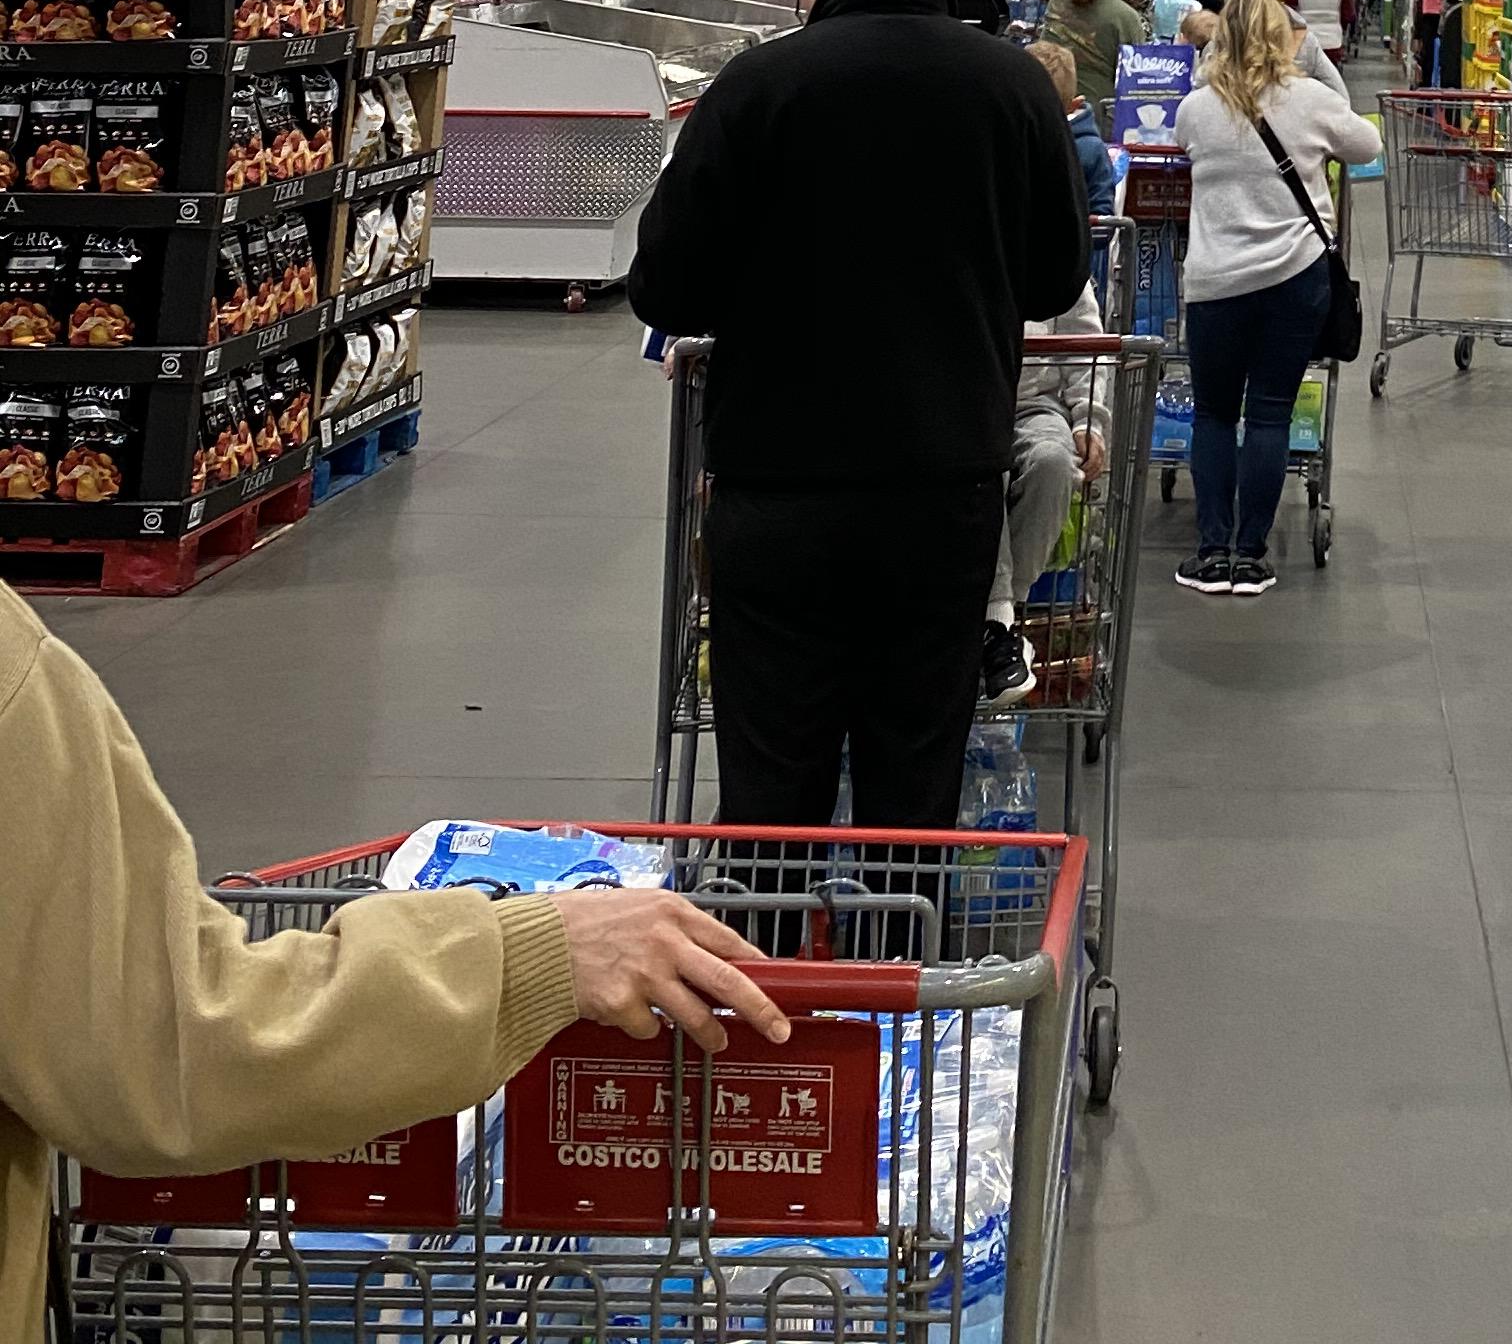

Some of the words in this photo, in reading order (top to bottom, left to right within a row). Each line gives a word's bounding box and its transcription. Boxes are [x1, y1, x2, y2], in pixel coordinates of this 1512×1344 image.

[284, 39, 316, 59] TERRA
[1122, 44, 1186, 77] Kleenex
[98, 79, 168, 97] TERRA
[273, 179, 305, 201] TERRA
[13, 231, 63, 251] ERRA
[256, 328, 289, 350] TERRA
[241, 467, 274, 497] TERRA
[556, 1071, 569, 1140] WARNING
[557, 1144, 661, 1169] COSTCO
